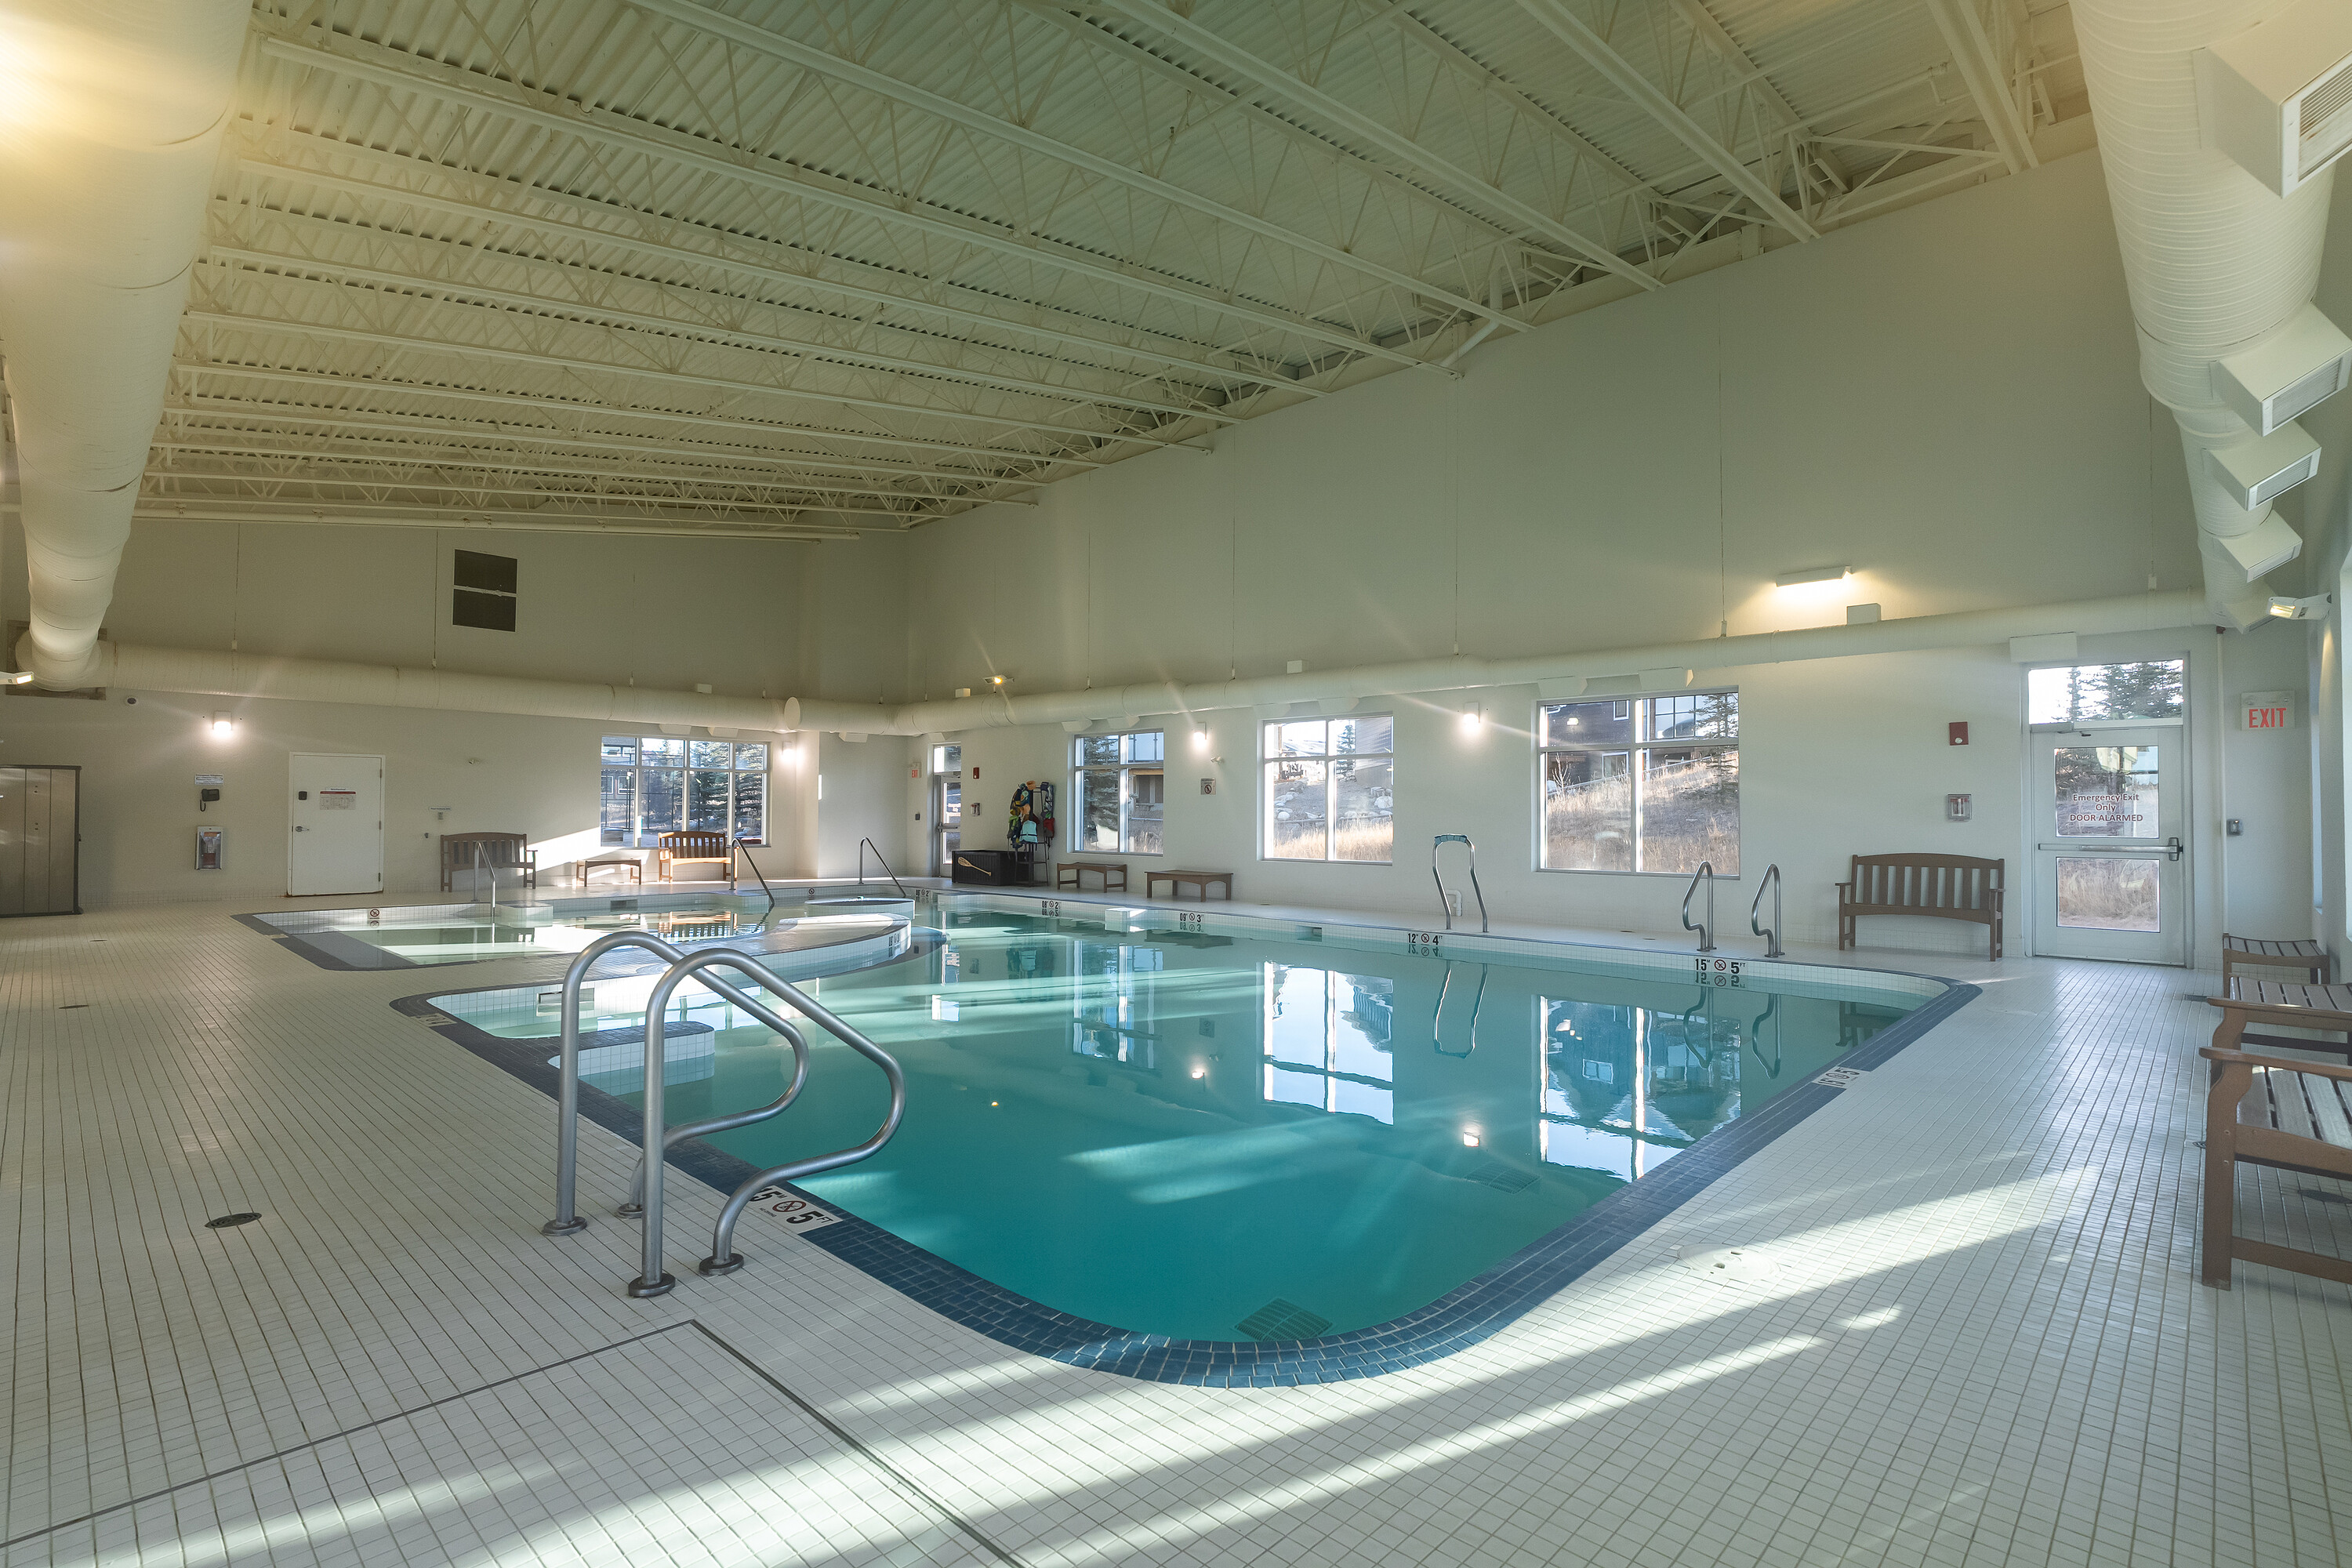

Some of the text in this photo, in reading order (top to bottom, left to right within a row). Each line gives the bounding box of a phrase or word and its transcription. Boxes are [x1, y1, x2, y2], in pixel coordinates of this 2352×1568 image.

[2249, 707, 2287, 728] EXIT
[2073, 793, 2120, 802] Emergency
[2096, 803, 2116, 811] Only
